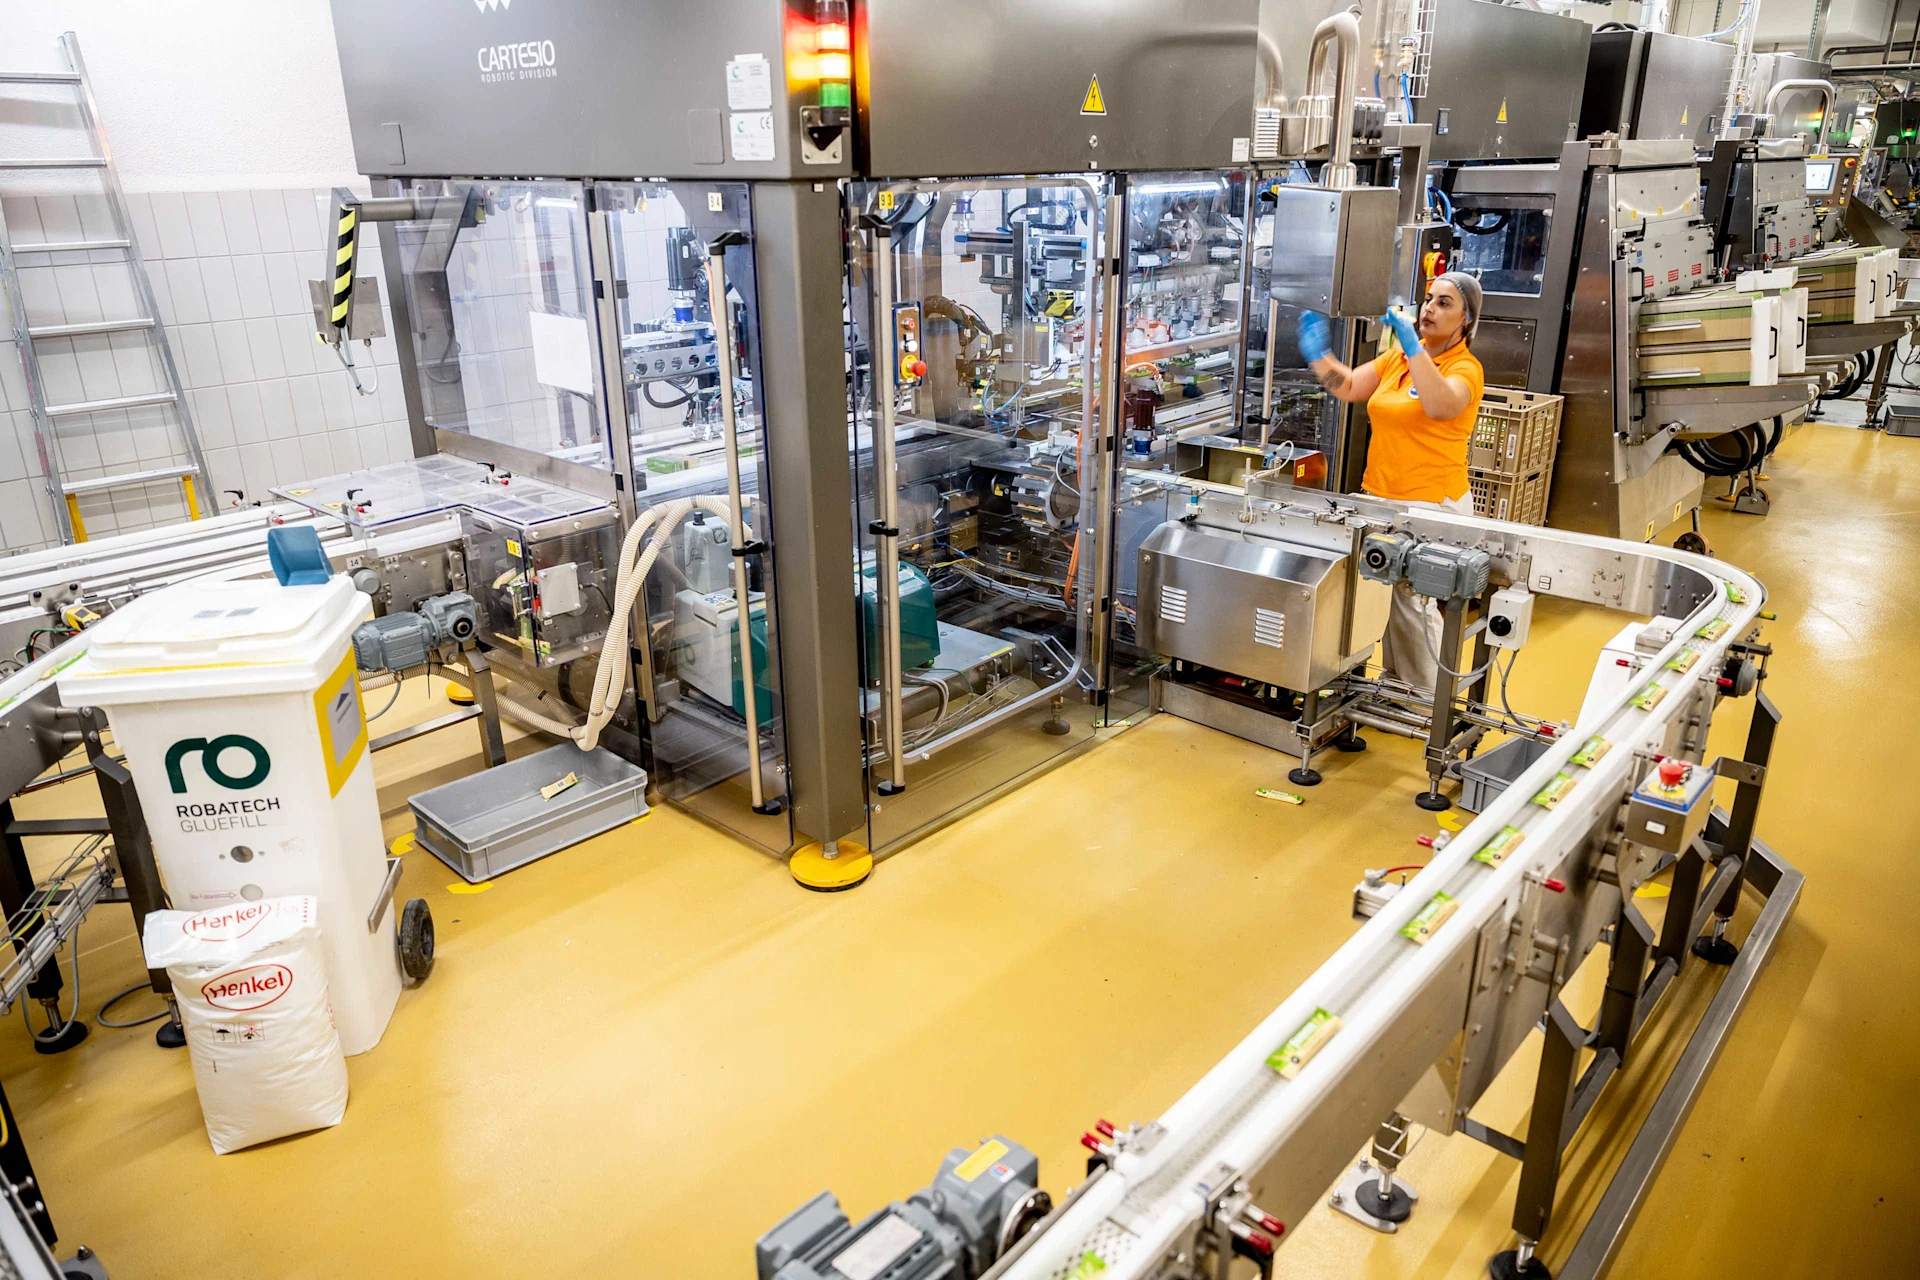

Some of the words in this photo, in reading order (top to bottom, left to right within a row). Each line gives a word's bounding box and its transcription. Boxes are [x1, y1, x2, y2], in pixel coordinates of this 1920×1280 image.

[478, 40, 556, 72] CARTESIO
[481, 71, 515, 83] ROBOTIC
[520, 68, 557, 80] DIVISION
[350, 559, 359, 567] 14
[176, 797, 281, 818] ROBATECH
[180, 815, 268, 833] GLUEFILL
[209, 971, 285, 998] Henkel
